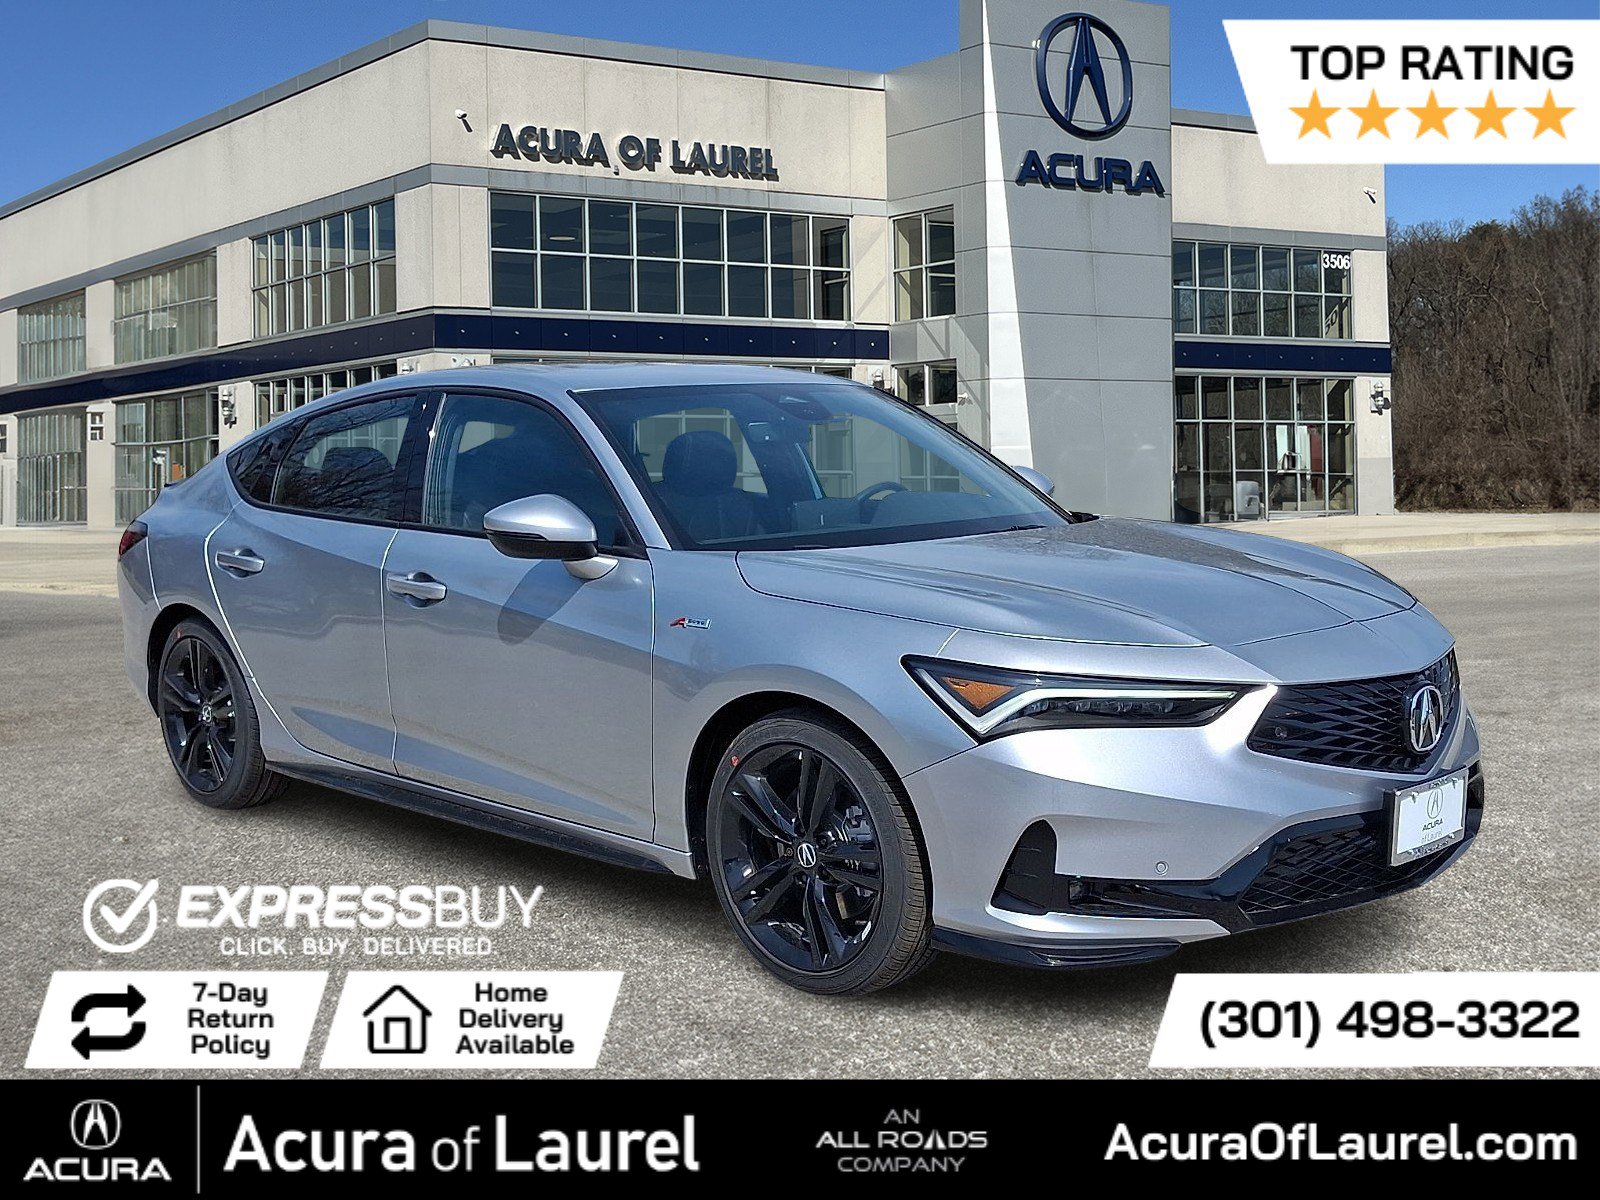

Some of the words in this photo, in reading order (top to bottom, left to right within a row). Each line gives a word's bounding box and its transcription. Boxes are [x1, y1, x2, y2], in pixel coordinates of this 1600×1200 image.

[491, 123, 611, 168] ACURA
[616, 134, 661, 171] OF
[669, 139, 779, 181] LAUREL
[1015, 149, 1165, 198] ACURA
[1322, 253, 1351, 270] 3506
[1422, 818, 1443, 831] ACURA
